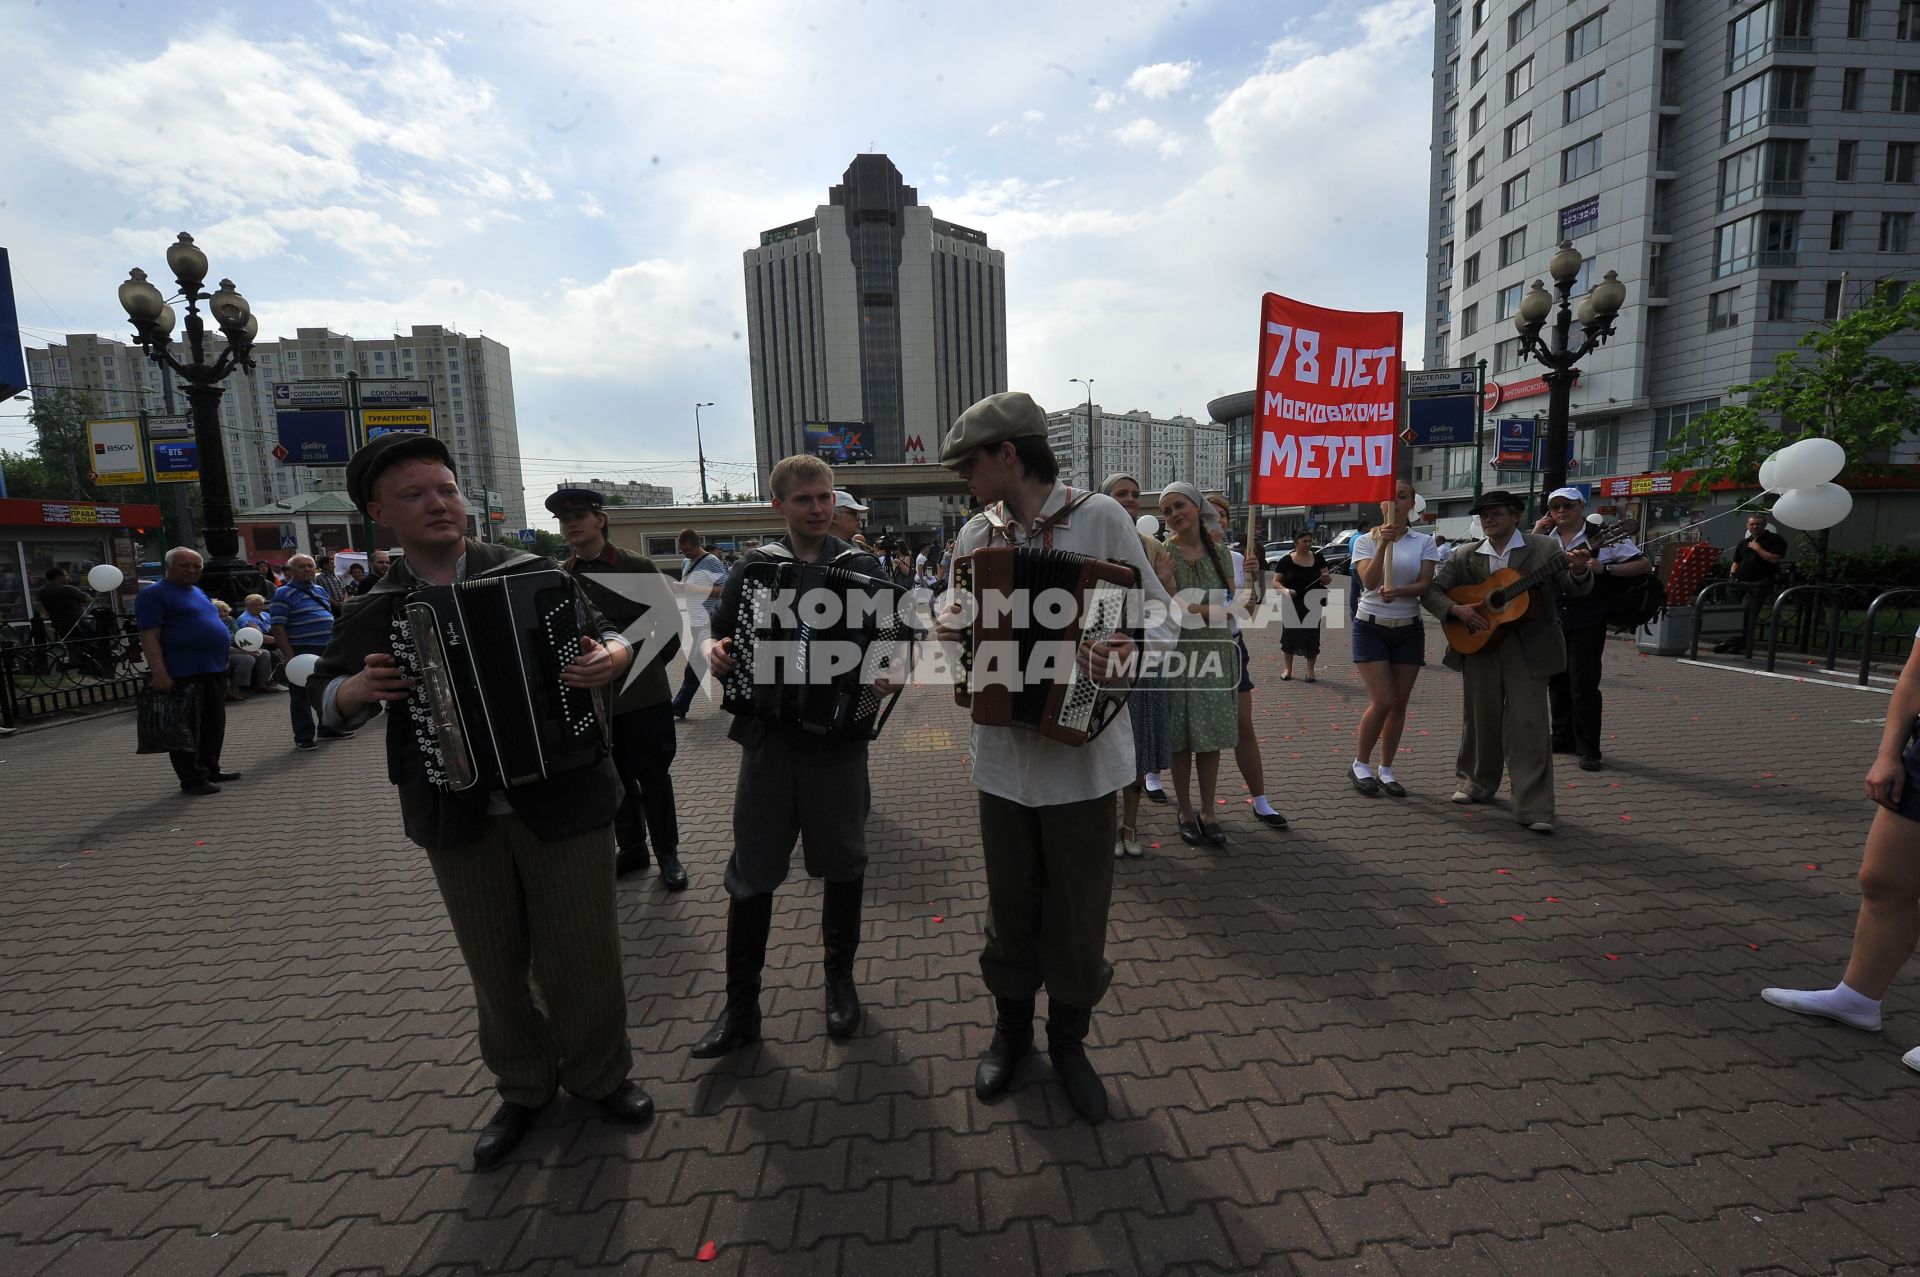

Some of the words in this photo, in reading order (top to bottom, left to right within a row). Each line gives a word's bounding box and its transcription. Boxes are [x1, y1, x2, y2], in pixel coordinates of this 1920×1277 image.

[1266, 321, 1320, 384] 78
[1330, 346, 1396, 388] ЛЕТ
[1412, 373, 1450, 382] ГАСТЕЛЛО
[107, 444, 134, 452] BSGV
[301, 442, 327, 451] Gallery
[168, 448, 183, 456] ВТБ
[1259, 431, 1393, 479] МЕТРО
[796, 621, 811, 673] FANTINI
